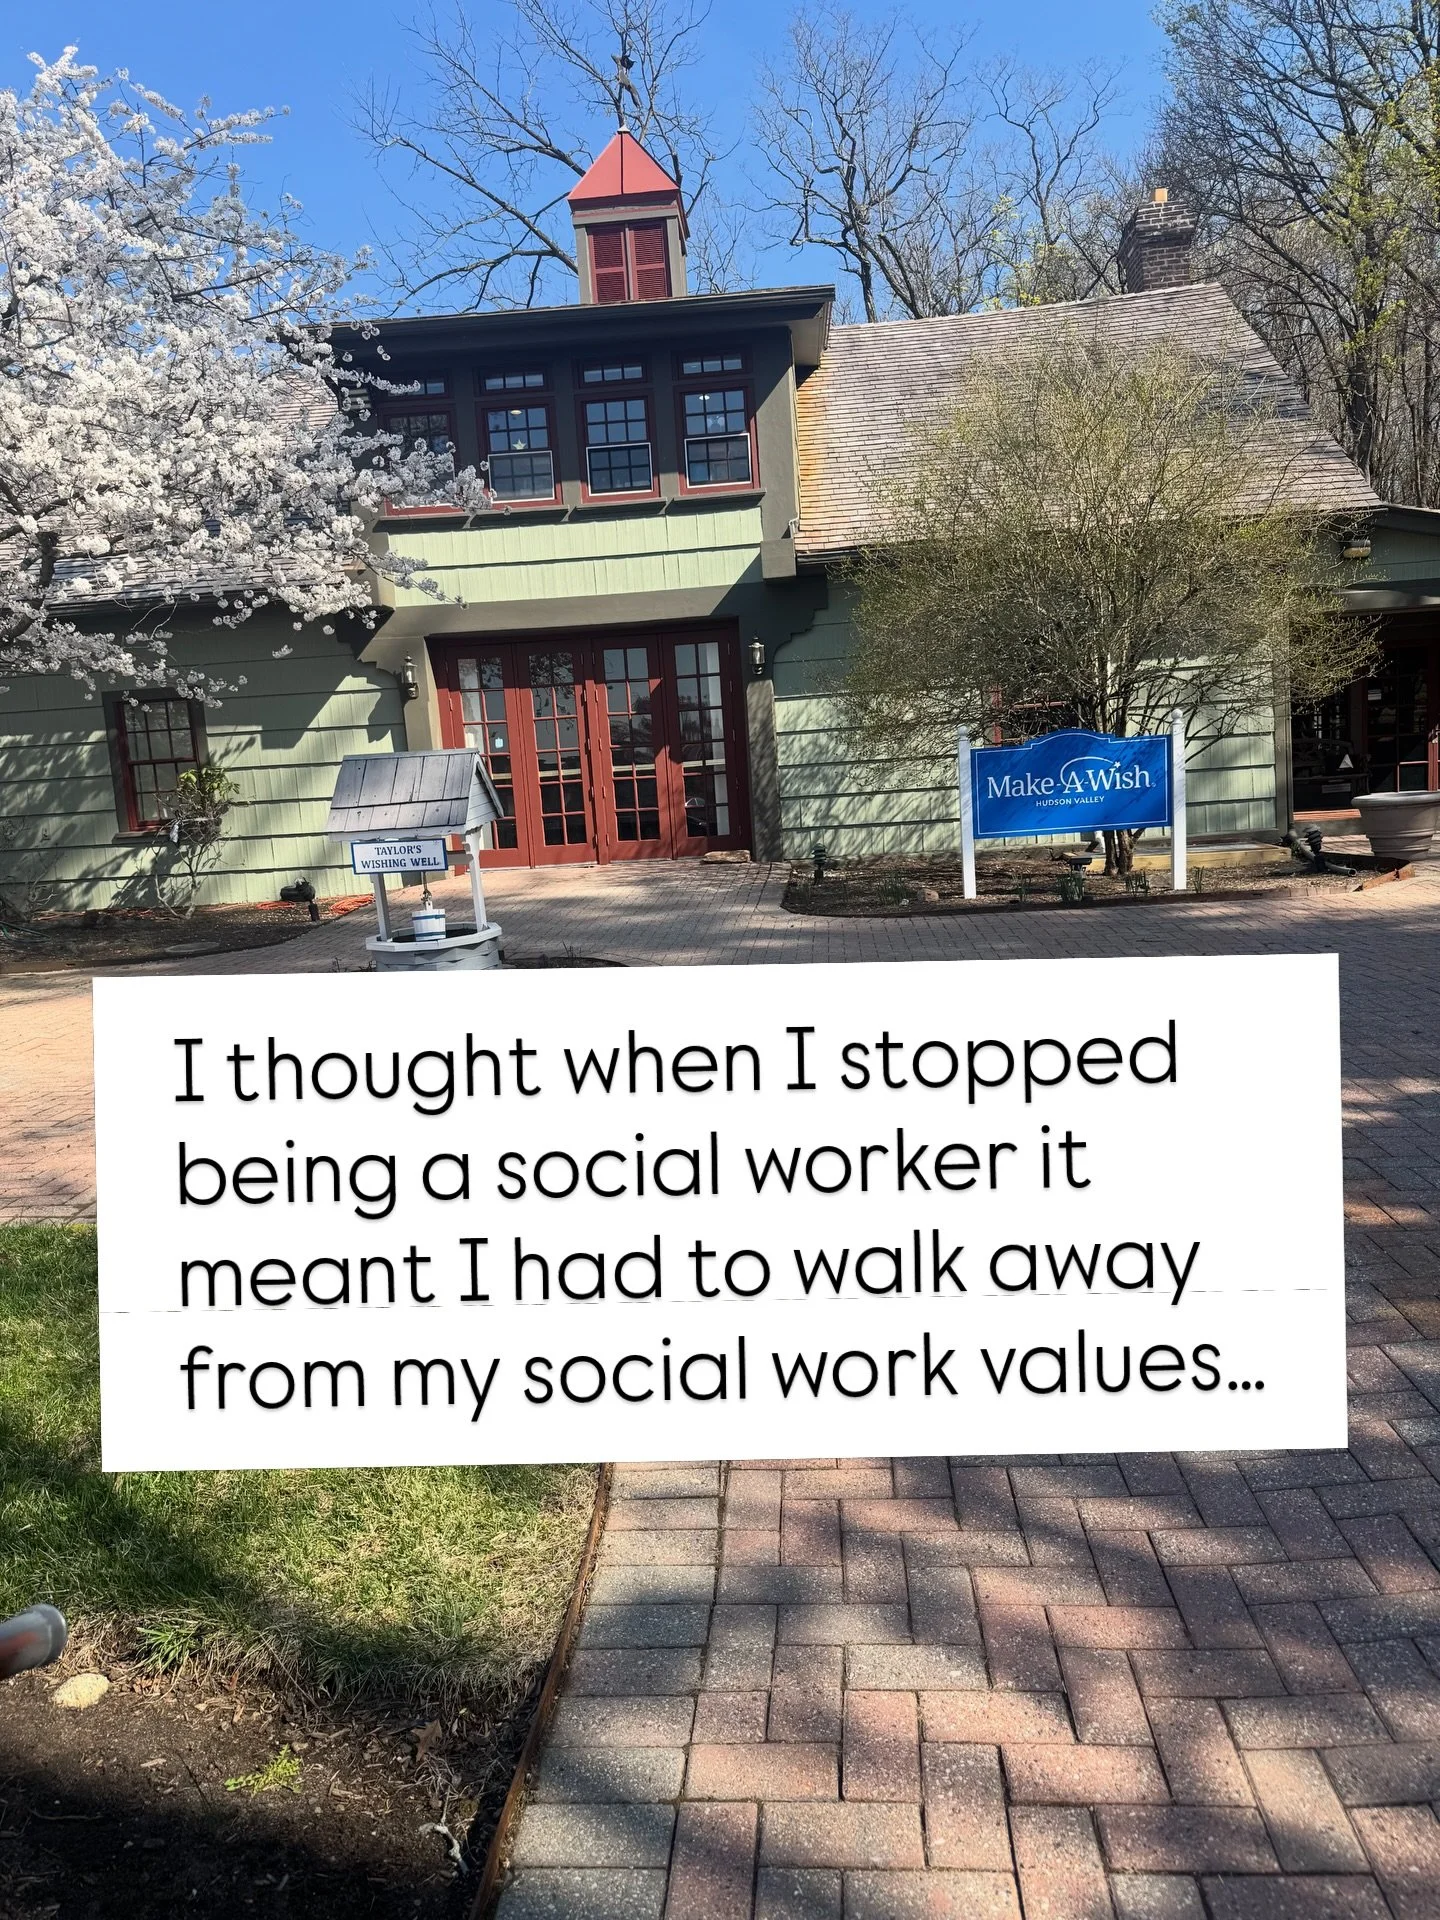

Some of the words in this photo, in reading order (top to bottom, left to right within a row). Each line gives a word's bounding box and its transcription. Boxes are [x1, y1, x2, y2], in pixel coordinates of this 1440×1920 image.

[1035, 797, 1072, 807] HUDSON
[1073, 795, 1105, 805] VALLEY
[374, 844, 422, 856] TAYLOR'S
[361, 857, 407, 869] WISHING
[410, 856, 440, 867] WELL
